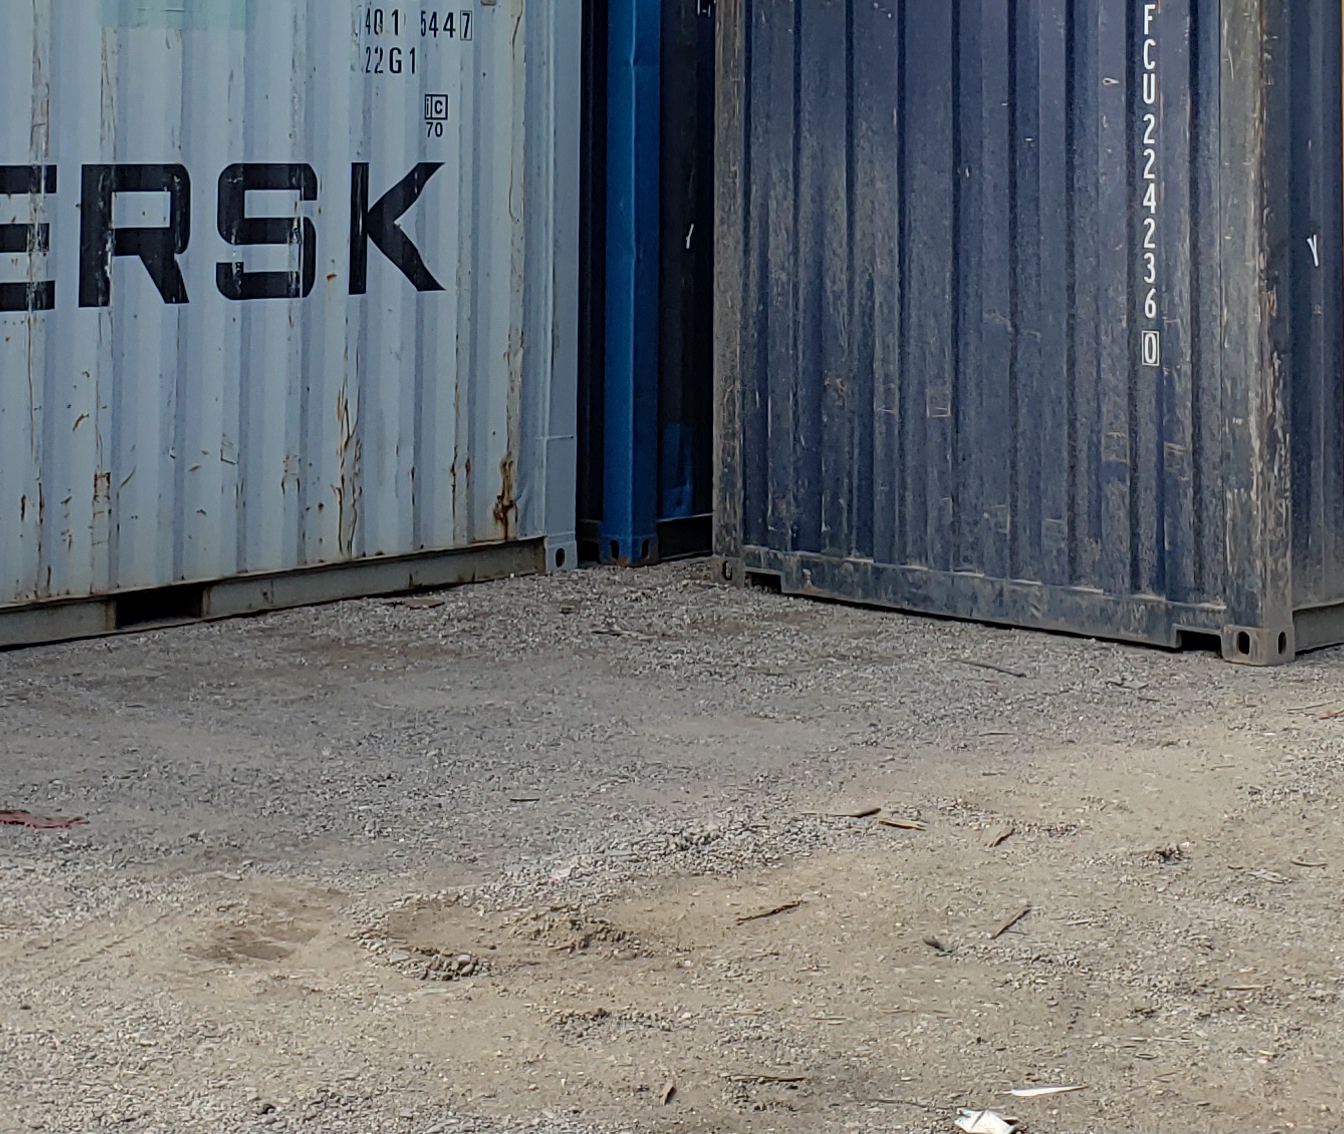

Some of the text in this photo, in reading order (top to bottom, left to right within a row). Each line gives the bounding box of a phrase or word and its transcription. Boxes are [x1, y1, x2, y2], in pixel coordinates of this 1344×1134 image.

[365, 7, 400, 36] 401
[365, 46, 416, 74] 22G1
[426, 122, 444, 138] 70
[1142, 114, 1156, 319] 224236
[1143, 332, 1158, 365] 0
